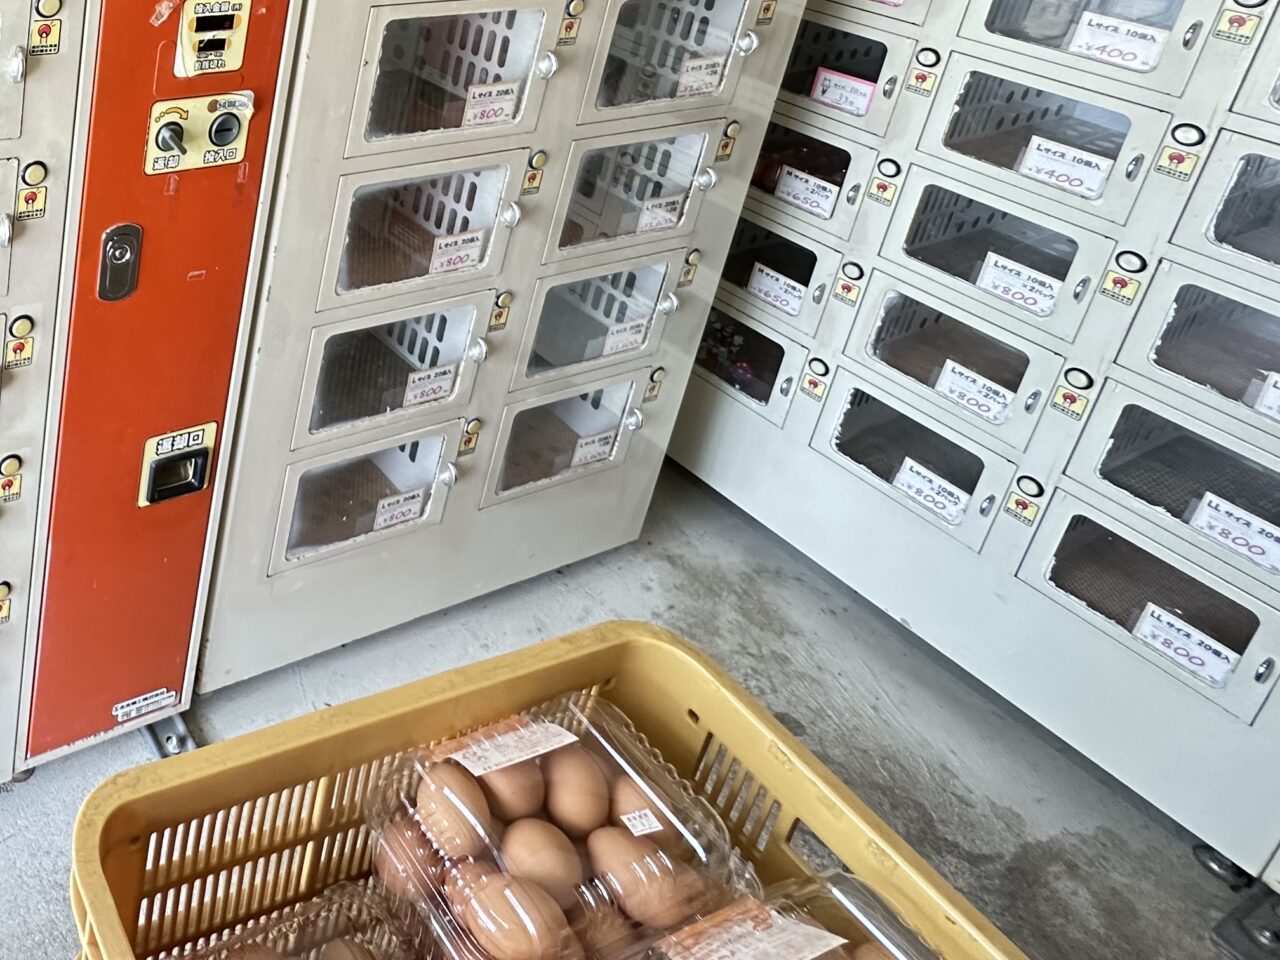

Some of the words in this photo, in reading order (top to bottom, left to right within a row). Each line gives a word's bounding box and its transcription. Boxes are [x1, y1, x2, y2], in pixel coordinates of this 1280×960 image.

[195, 2, 230, 14] 投入金額
[1087, 18, 1119, 33] Lサイズ
[1125, 29, 1156, 43] 10個入
[1085, 43, 1138, 61] ¥400
[153, 155, 180, 171] 返却
[204, 148, 237, 164] 投入口
[1036, 143, 1066, 159] Lサイズ
[1071, 155, 1101, 171] 10個入
[1035, 166, 1083, 187] ¥400
[156, 429, 205, 455] 返却口
[1206, 520, 1266, 556] ¥800
[1150, 630, 1205, 668] ¥800
[1197, 639, 1231, 664] 20個入
